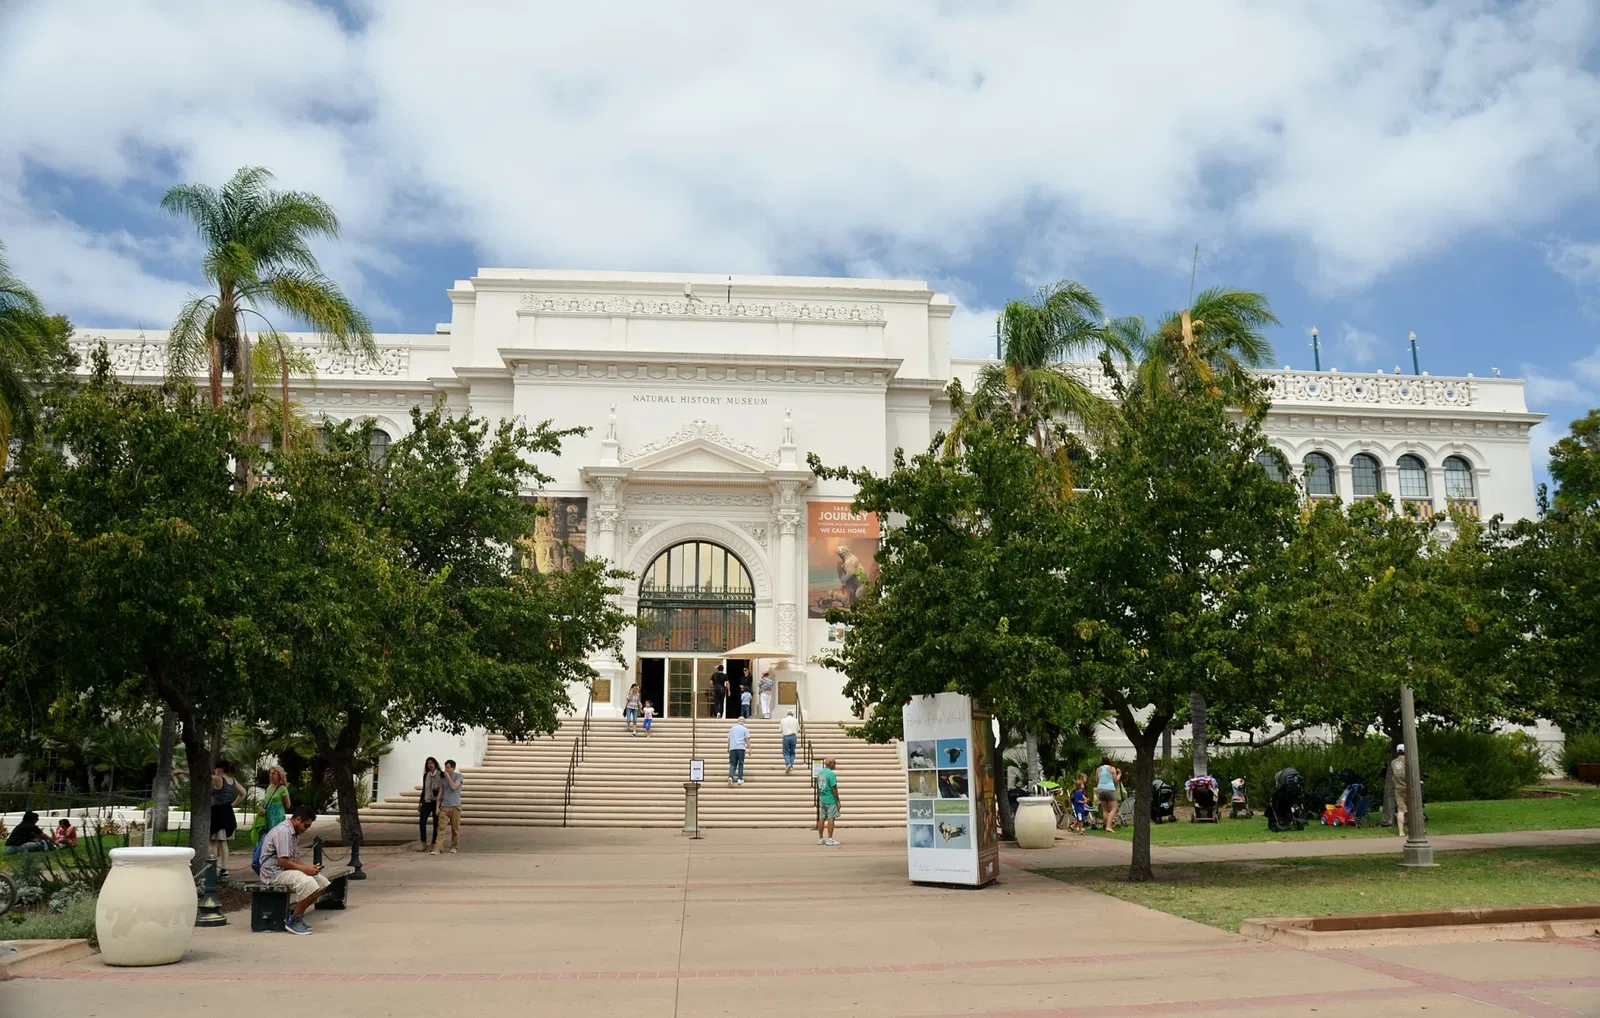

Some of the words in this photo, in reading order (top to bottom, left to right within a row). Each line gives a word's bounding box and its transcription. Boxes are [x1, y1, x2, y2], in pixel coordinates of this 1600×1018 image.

[632, 395, 676, 404] NATURAL
[680, 396, 722, 405] HISTORY
[726, 397, 768, 406] MUSEUM
[818, 511, 869, 521] JOURNEY
